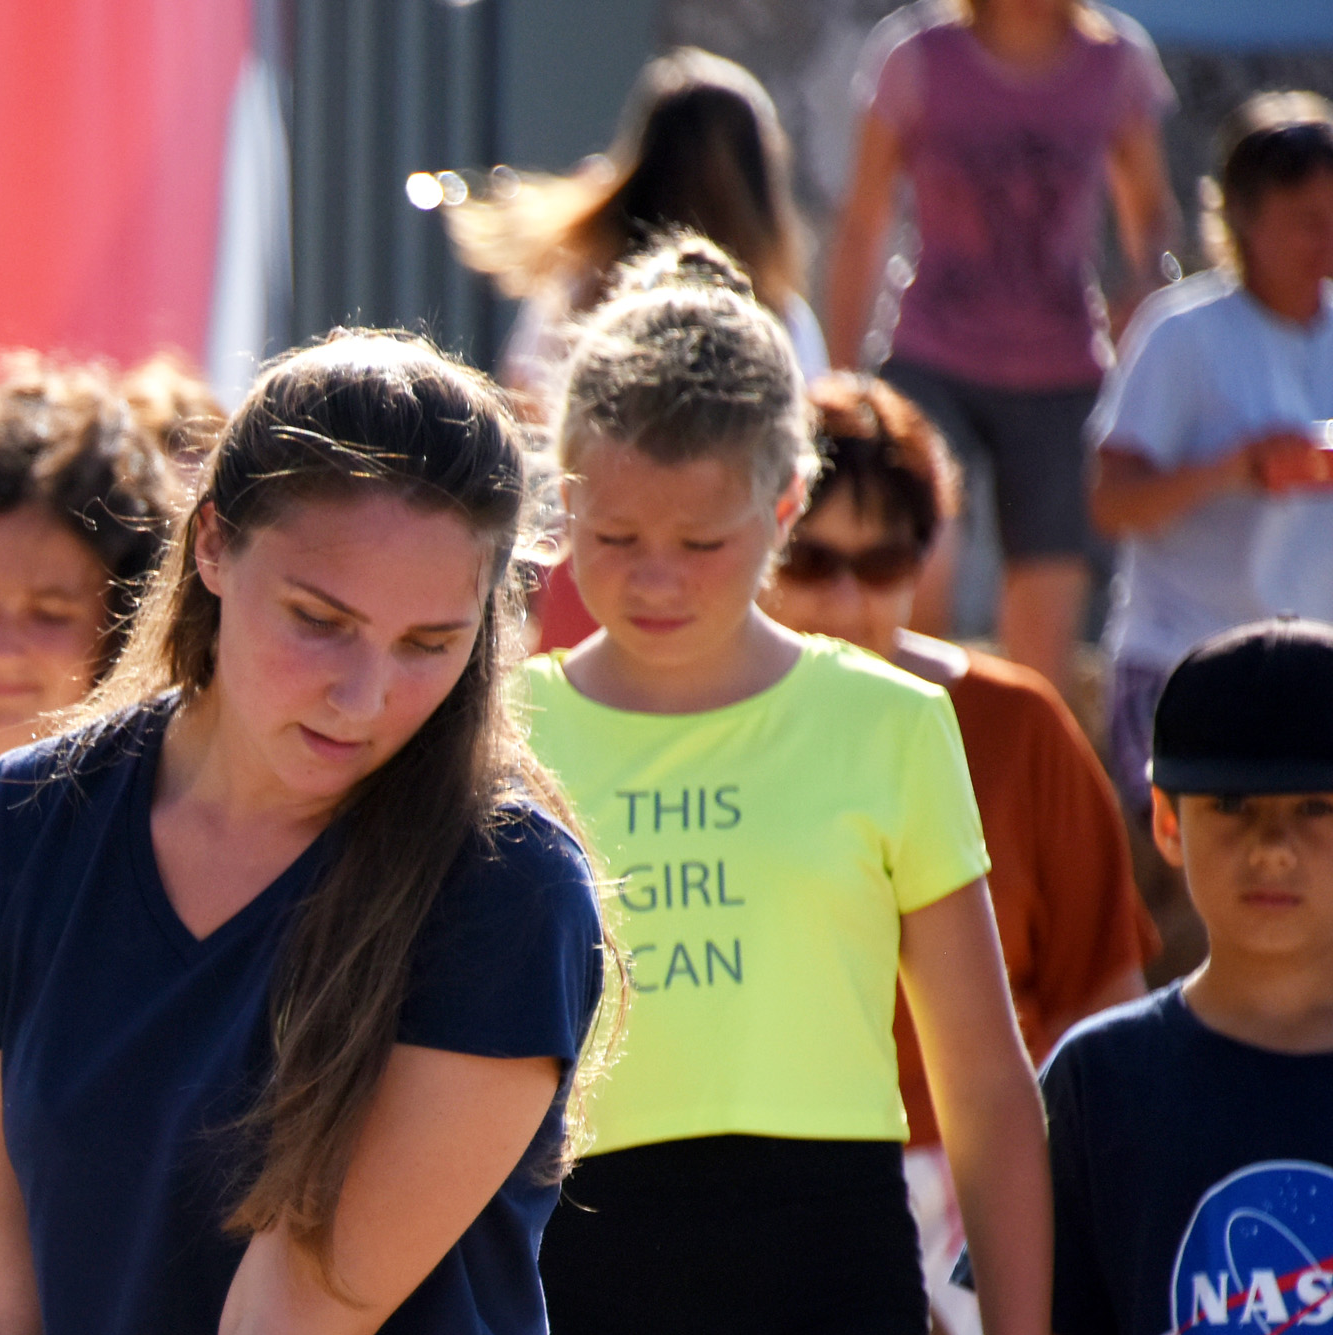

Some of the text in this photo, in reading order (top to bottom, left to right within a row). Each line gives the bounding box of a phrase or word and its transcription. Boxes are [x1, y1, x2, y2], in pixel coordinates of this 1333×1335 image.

[616, 785, 742, 834] THIS
[618, 859, 746, 913] GIRL
[627, 938, 743, 993] CAN
[1191, 1268, 1333, 1326] NAS
